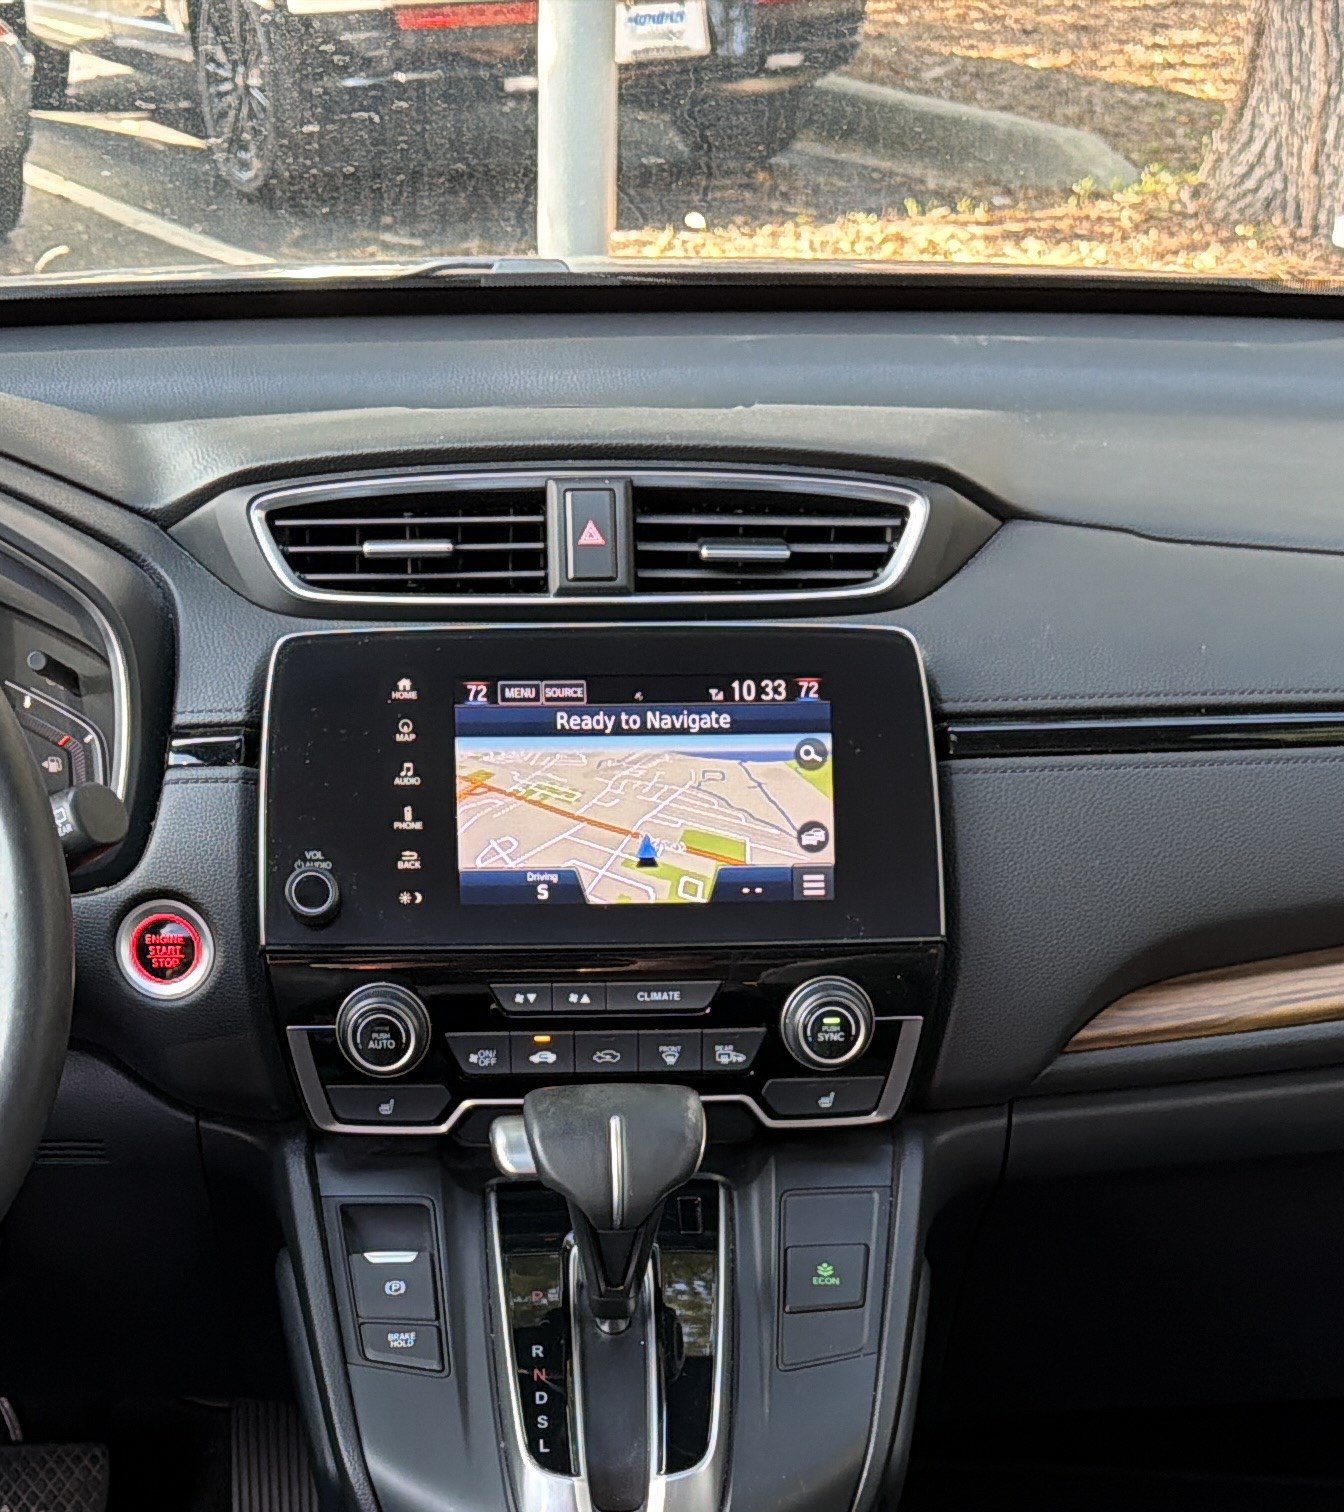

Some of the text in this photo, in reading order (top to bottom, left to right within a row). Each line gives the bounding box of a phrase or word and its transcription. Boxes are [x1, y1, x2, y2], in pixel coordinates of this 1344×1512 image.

[391, 691, 418, 700] HOME
[466, 684, 488, 702] 72
[505, 687, 536, 699] MENU
[545, 687, 584, 698] SOURCE
[799, 681, 819, 699] 72
[556, 711, 731, 733] Ready to Navigate
[395, 733, 417, 742] MAP
[393, 776, 421, 786] AUDIO
[393, 820, 423, 830] PHONE
[304, 850, 325, 860] VOL
[397, 860, 421, 870] BACK
[527, 872, 558, 885] Driving
[537, 884, 549, 900] S
[145, 933, 185, 945] ENGINE
[148, 945, 182, 956] START
[152, 958, 180, 968] STOP
[637, 990, 681, 1001] CLIMATE
[817, 1031, 846, 1042] SYNC
[368, 1039, 396, 1050] AUTO
[658, 1045, 682, 1053] FRONT
[812, 1276, 841, 1286] ECON
[387, 1332, 416, 1341] BRAKE
[389, 1340, 415, 1348] HOLD
[531, 1345, 545, 1358] R
[533, 1368, 547, 1382] N
[535, 1391, 548, 1405] D
[537, 1415, 549, 1429] S
[539, 1439, 551, 1453] L
